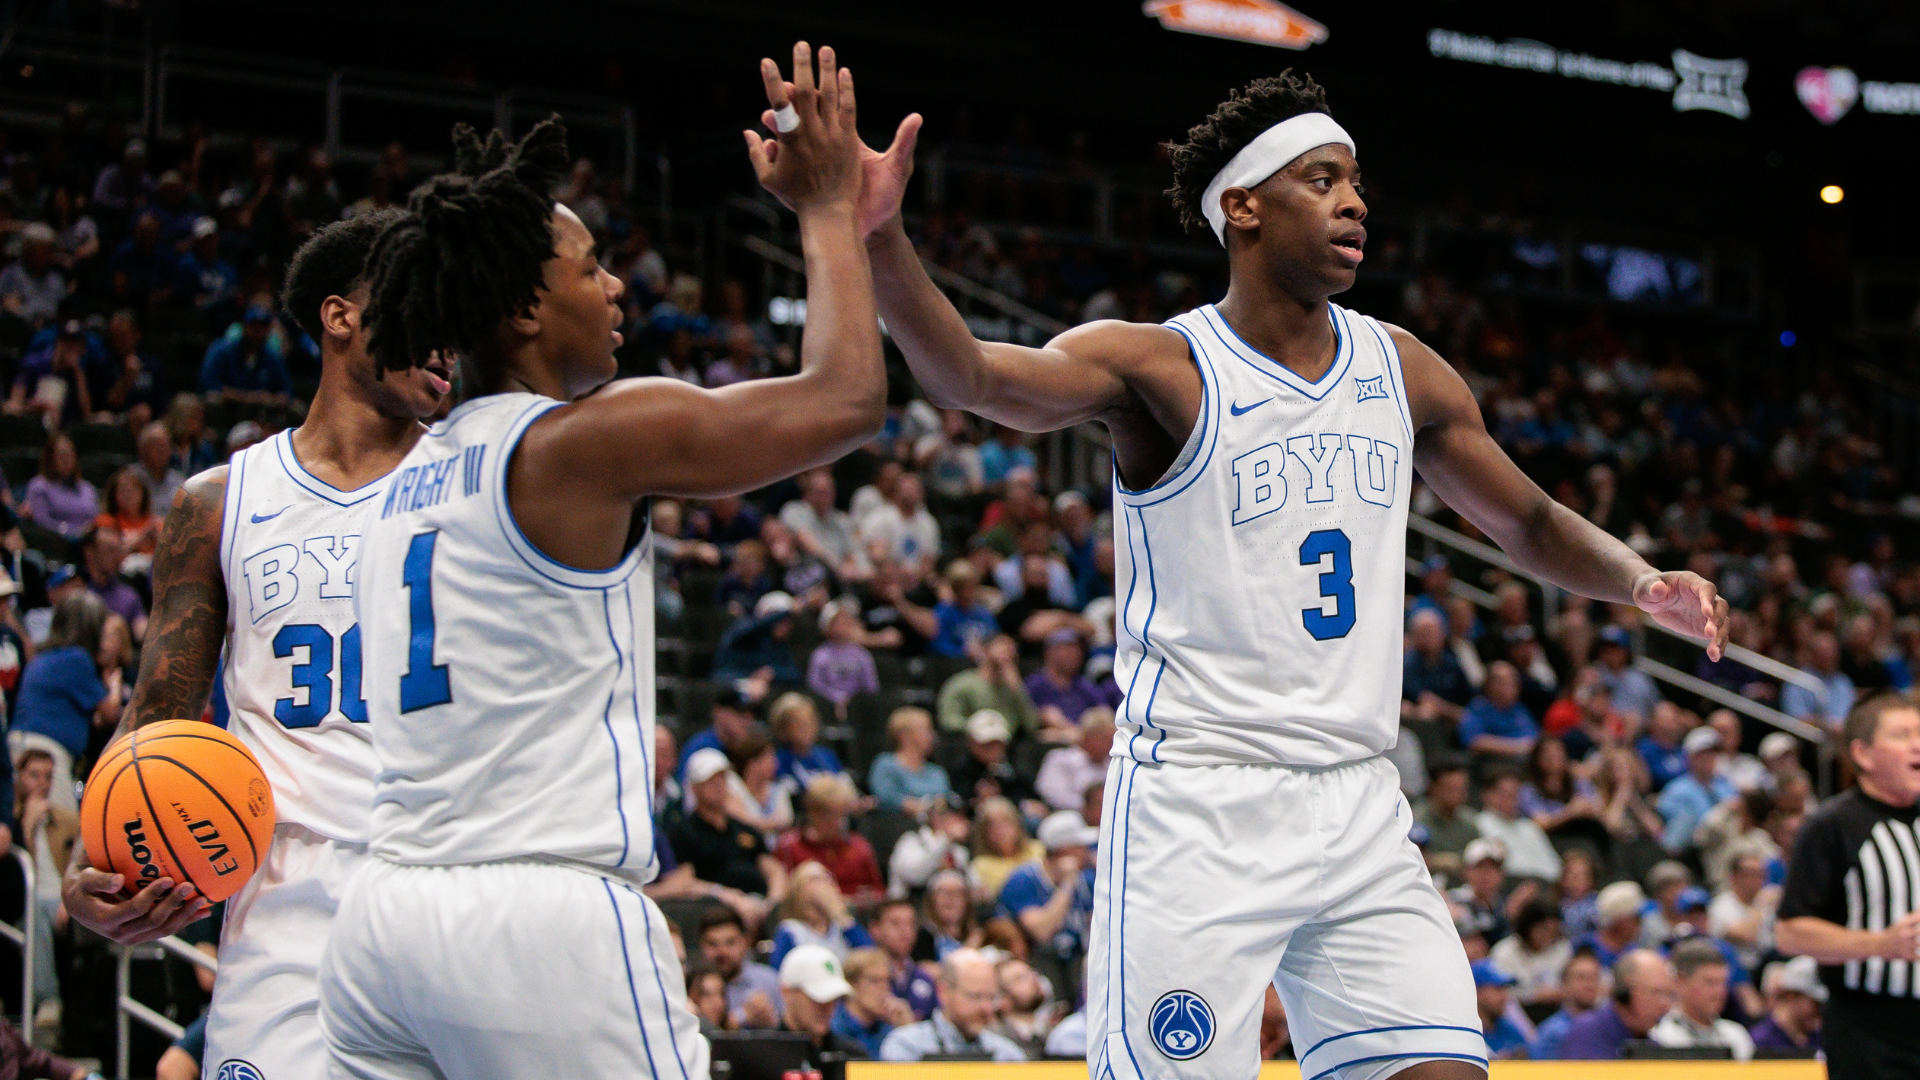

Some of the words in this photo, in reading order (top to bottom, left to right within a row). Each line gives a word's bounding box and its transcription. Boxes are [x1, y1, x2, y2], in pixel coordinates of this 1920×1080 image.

[463, 443, 487, 498] III
[1232, 433, 1399, 527] BYU
[243, 534, 361, 625] BY
[400, 528, 453, 715] 1
[1299, 528, 1356, 641] 3
[169, 802, 192, 822] NXT
[1170, 1031, 1192, 1048] Y
